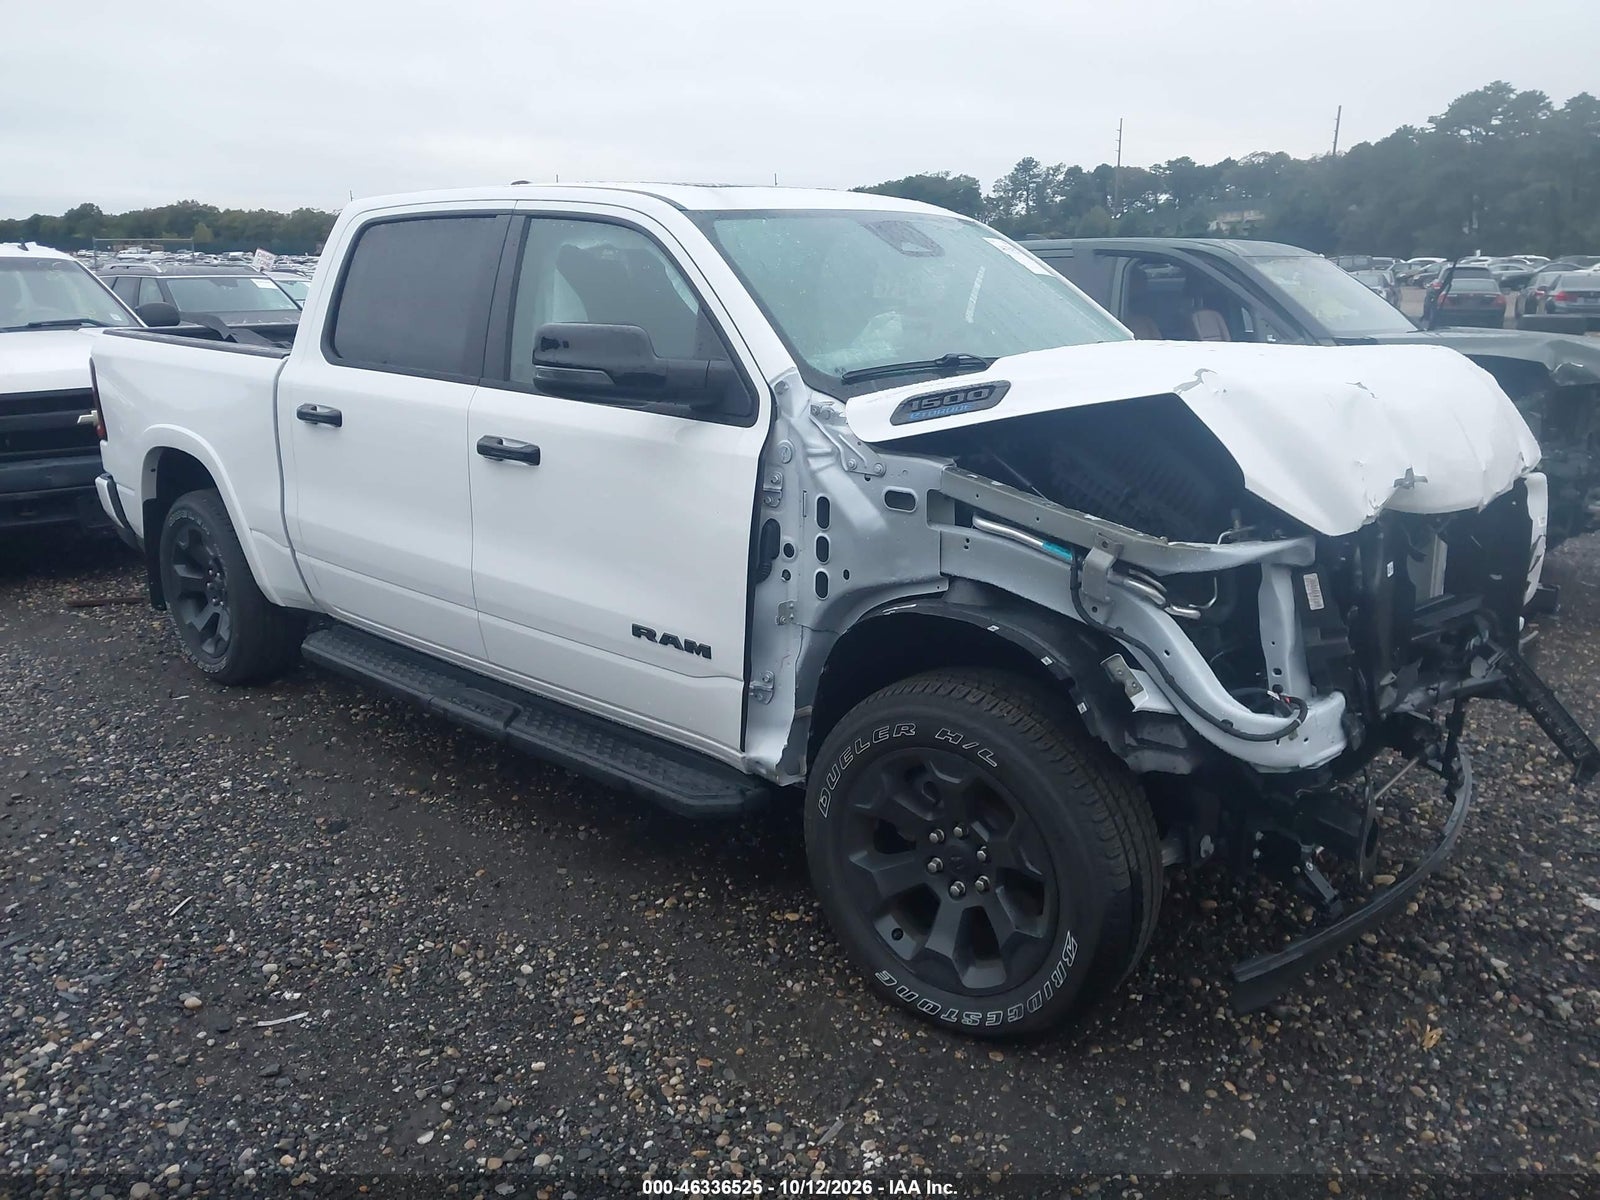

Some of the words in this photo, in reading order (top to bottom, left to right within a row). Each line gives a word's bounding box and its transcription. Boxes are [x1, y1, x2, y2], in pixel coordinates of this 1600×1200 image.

[911, 388, 991, 411] 1500
[631, 623, 712, 660] RAM
[817, 722, 917, 819] DUELER
[934, 727, 998, 768] H/L
[874, 929, 1078, 1027] BRIDGESTONE
